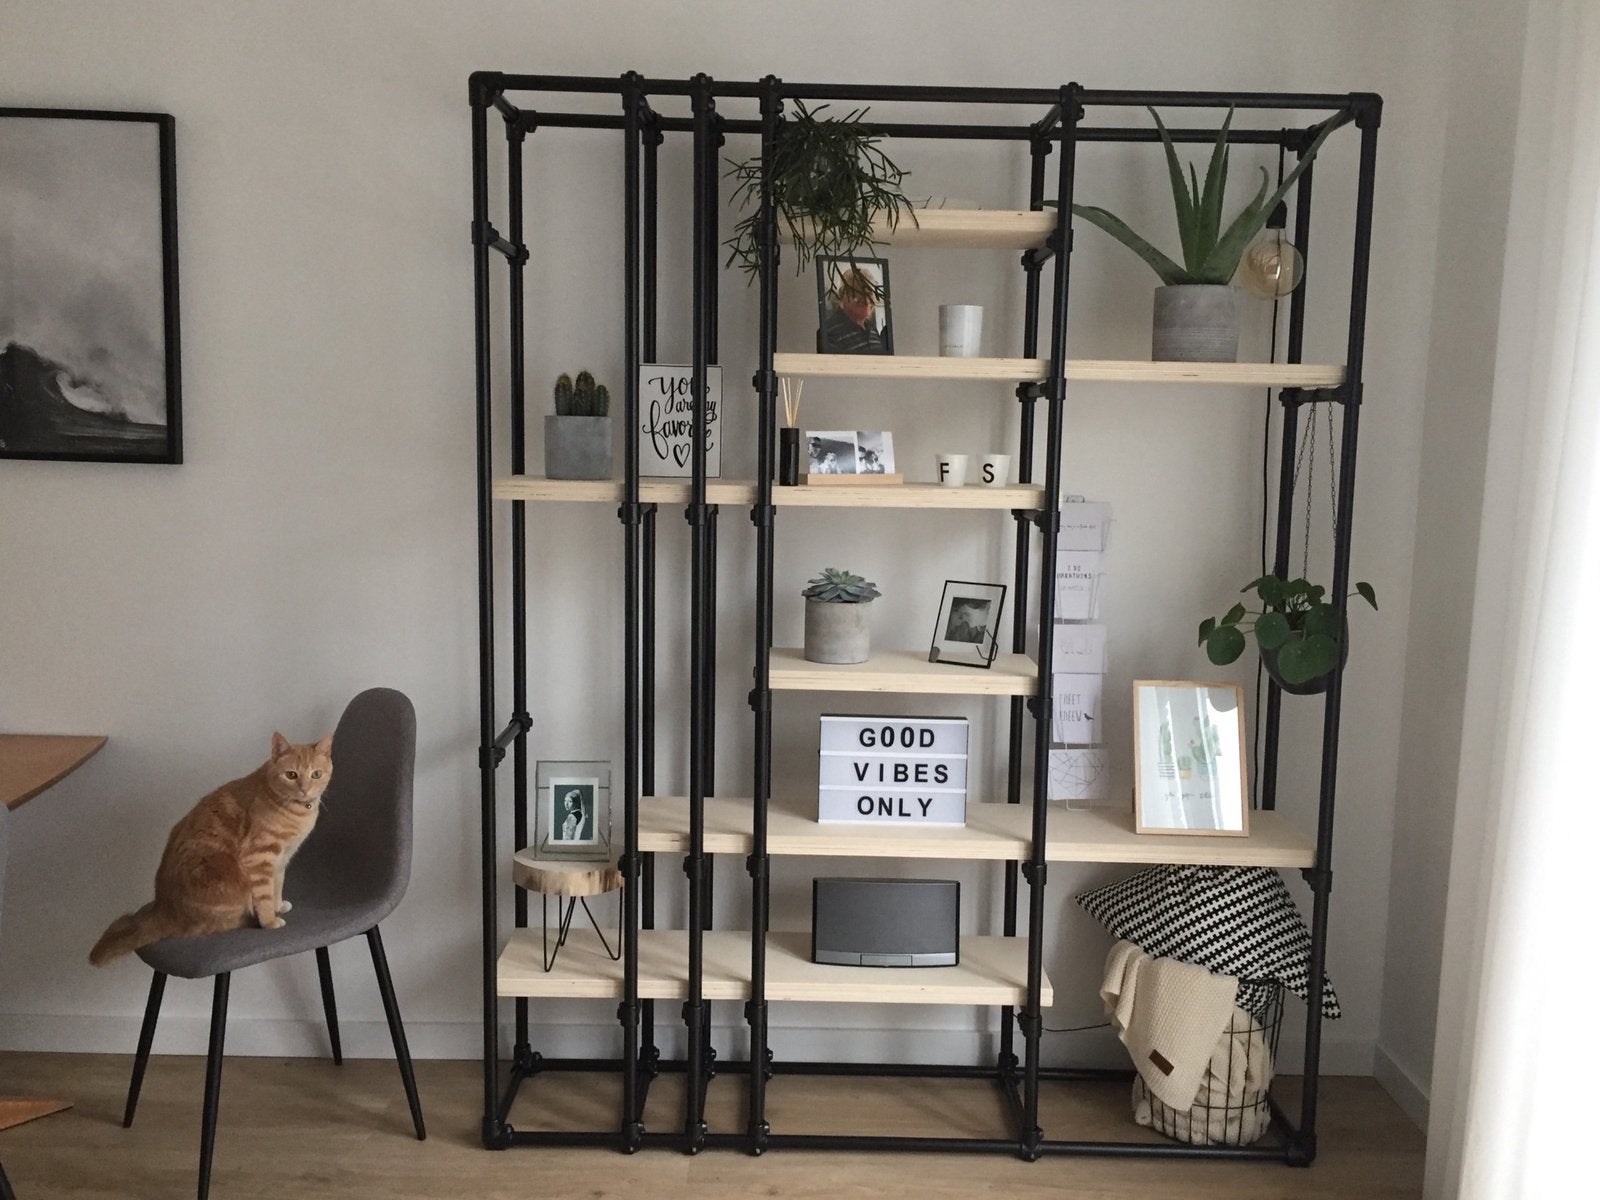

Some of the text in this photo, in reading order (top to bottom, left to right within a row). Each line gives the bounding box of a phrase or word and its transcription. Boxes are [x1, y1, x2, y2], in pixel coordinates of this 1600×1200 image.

[648, 376, 710, 414] yo
[642, 400, 715, 460] favore
[940, 462, 950, 482] F
[982, 463, 995, 484] S
[853, 762, 949, 784] VIBES
[857, 796, 933, 817] ONLY
